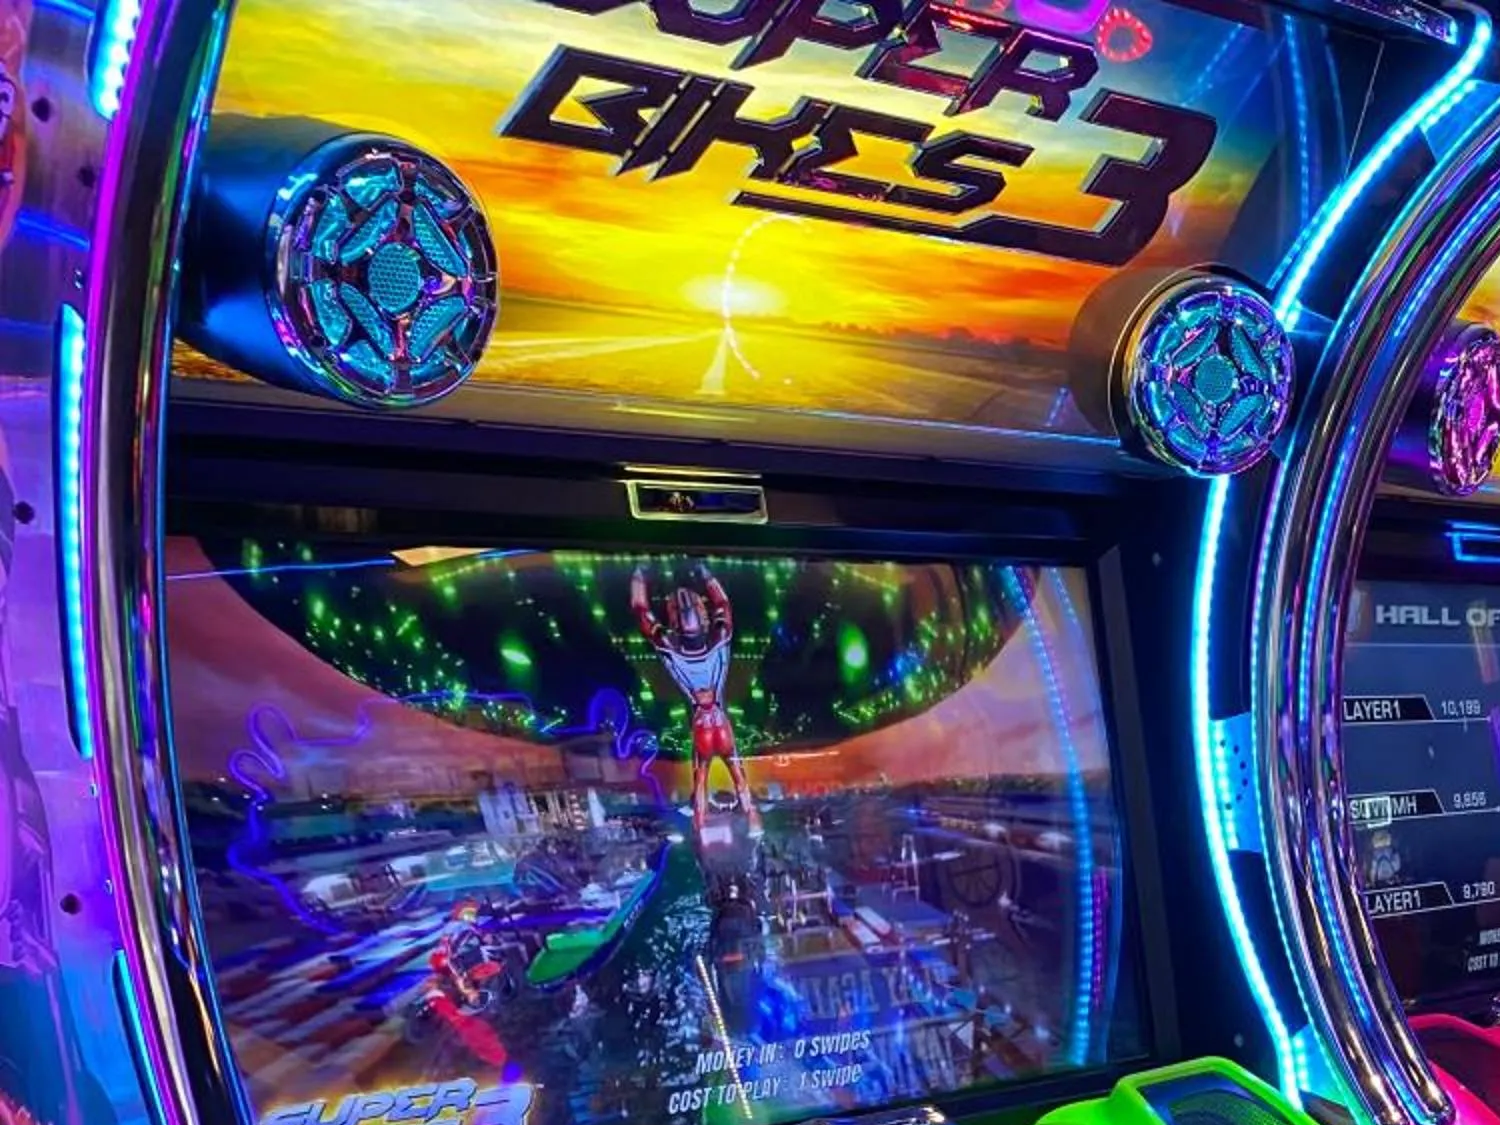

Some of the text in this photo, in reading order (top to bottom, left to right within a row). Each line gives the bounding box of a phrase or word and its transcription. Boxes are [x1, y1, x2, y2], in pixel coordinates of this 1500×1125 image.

[550, 0, 1099, 122] UPER
[496, 43, 1217, 266] BIKES 3
[1376, 605, 1461, 626] HALL
[1344, 700, 1401, 720] LAYER1
[1366, 889, 1421, 914] LAYER1
[695, 1045, 752, 1075] MONEY
[668, 1086, 711, 1115] COST
[717, 1083, 737, 1106] TO
